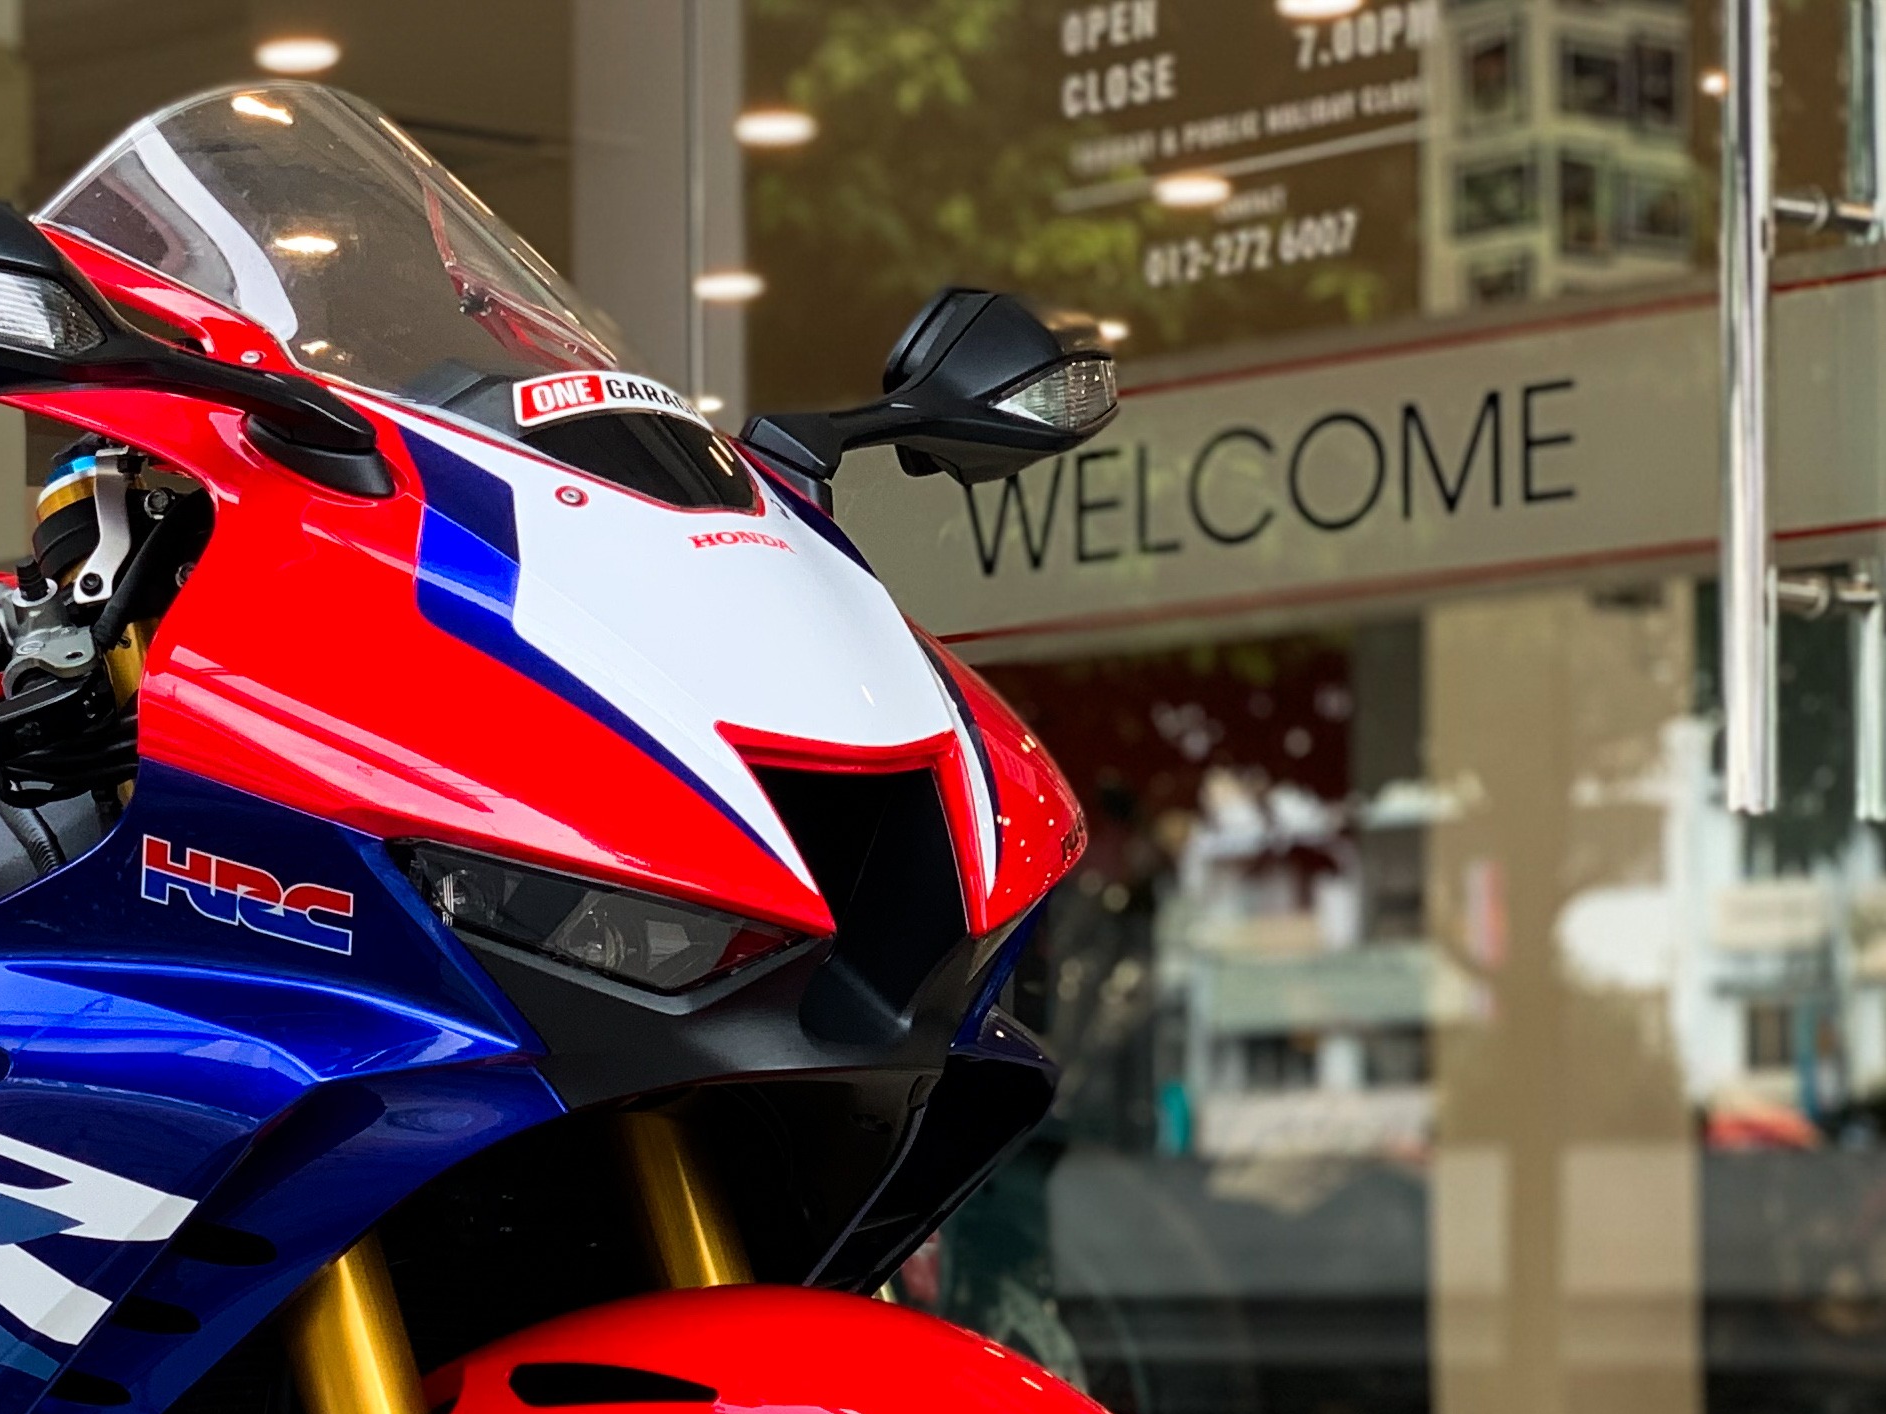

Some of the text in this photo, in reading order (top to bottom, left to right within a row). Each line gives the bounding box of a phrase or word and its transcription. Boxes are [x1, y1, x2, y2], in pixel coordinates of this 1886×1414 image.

[1063, 0, 1157, 55] OPEN
[1063, 55, 1176, 117] CLOSE
[531, 378, 596, 413] ONE
[964, 379, 1575, 577] WELCOME
[688, 531, 796, 553] HONDA
[141, 833, 354, 956] HRC
